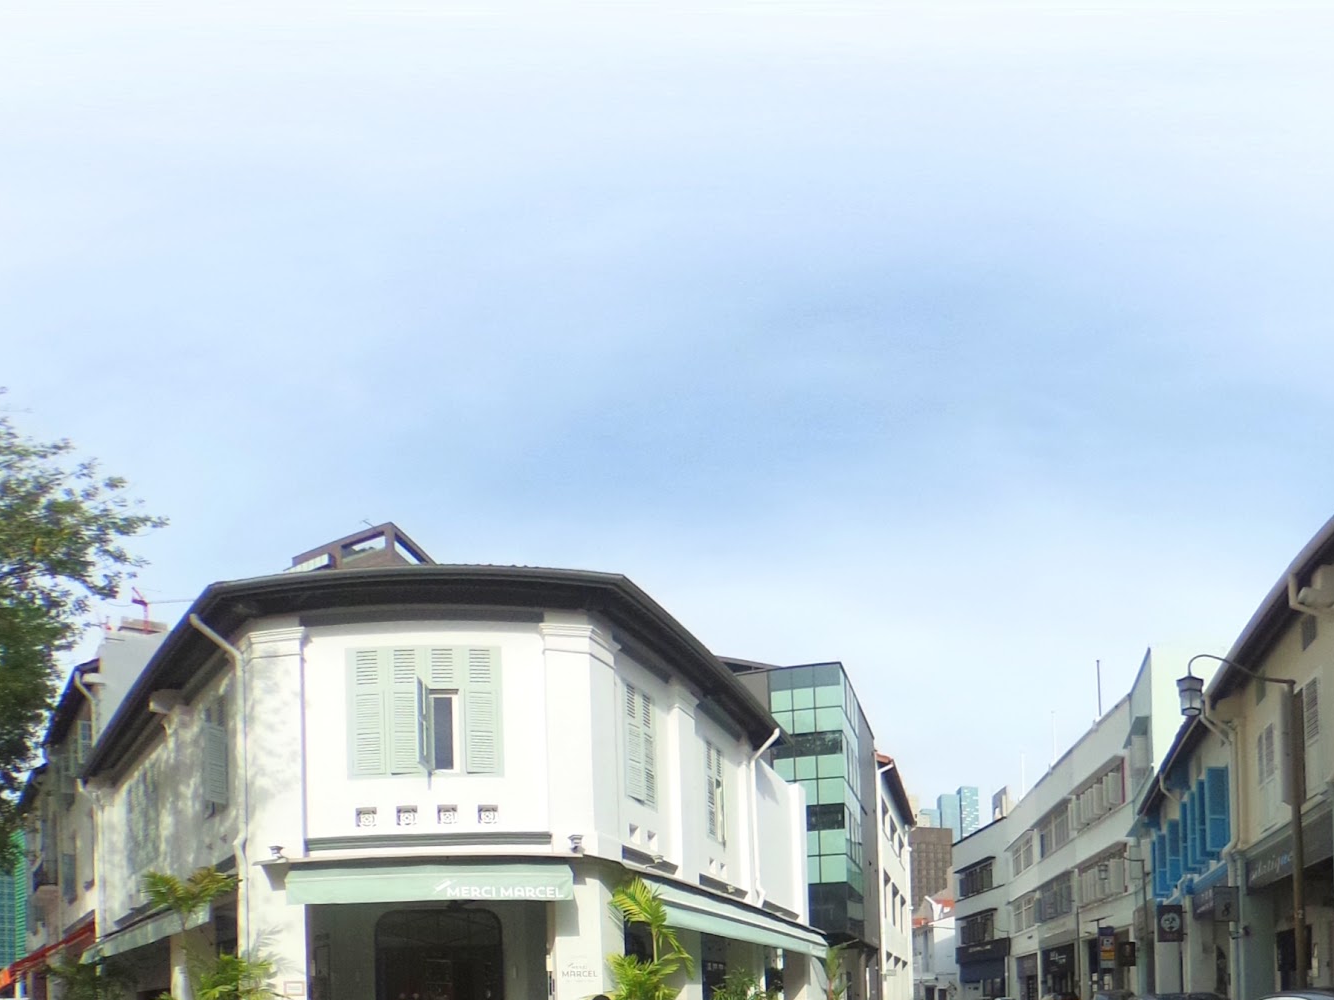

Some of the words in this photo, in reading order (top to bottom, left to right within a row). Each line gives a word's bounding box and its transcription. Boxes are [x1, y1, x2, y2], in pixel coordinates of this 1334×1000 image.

[446, 887, 496, 898] MERCI
[499, 887, 564, 898] MARCEL
[561, 970, 598, 978] MARCEL
